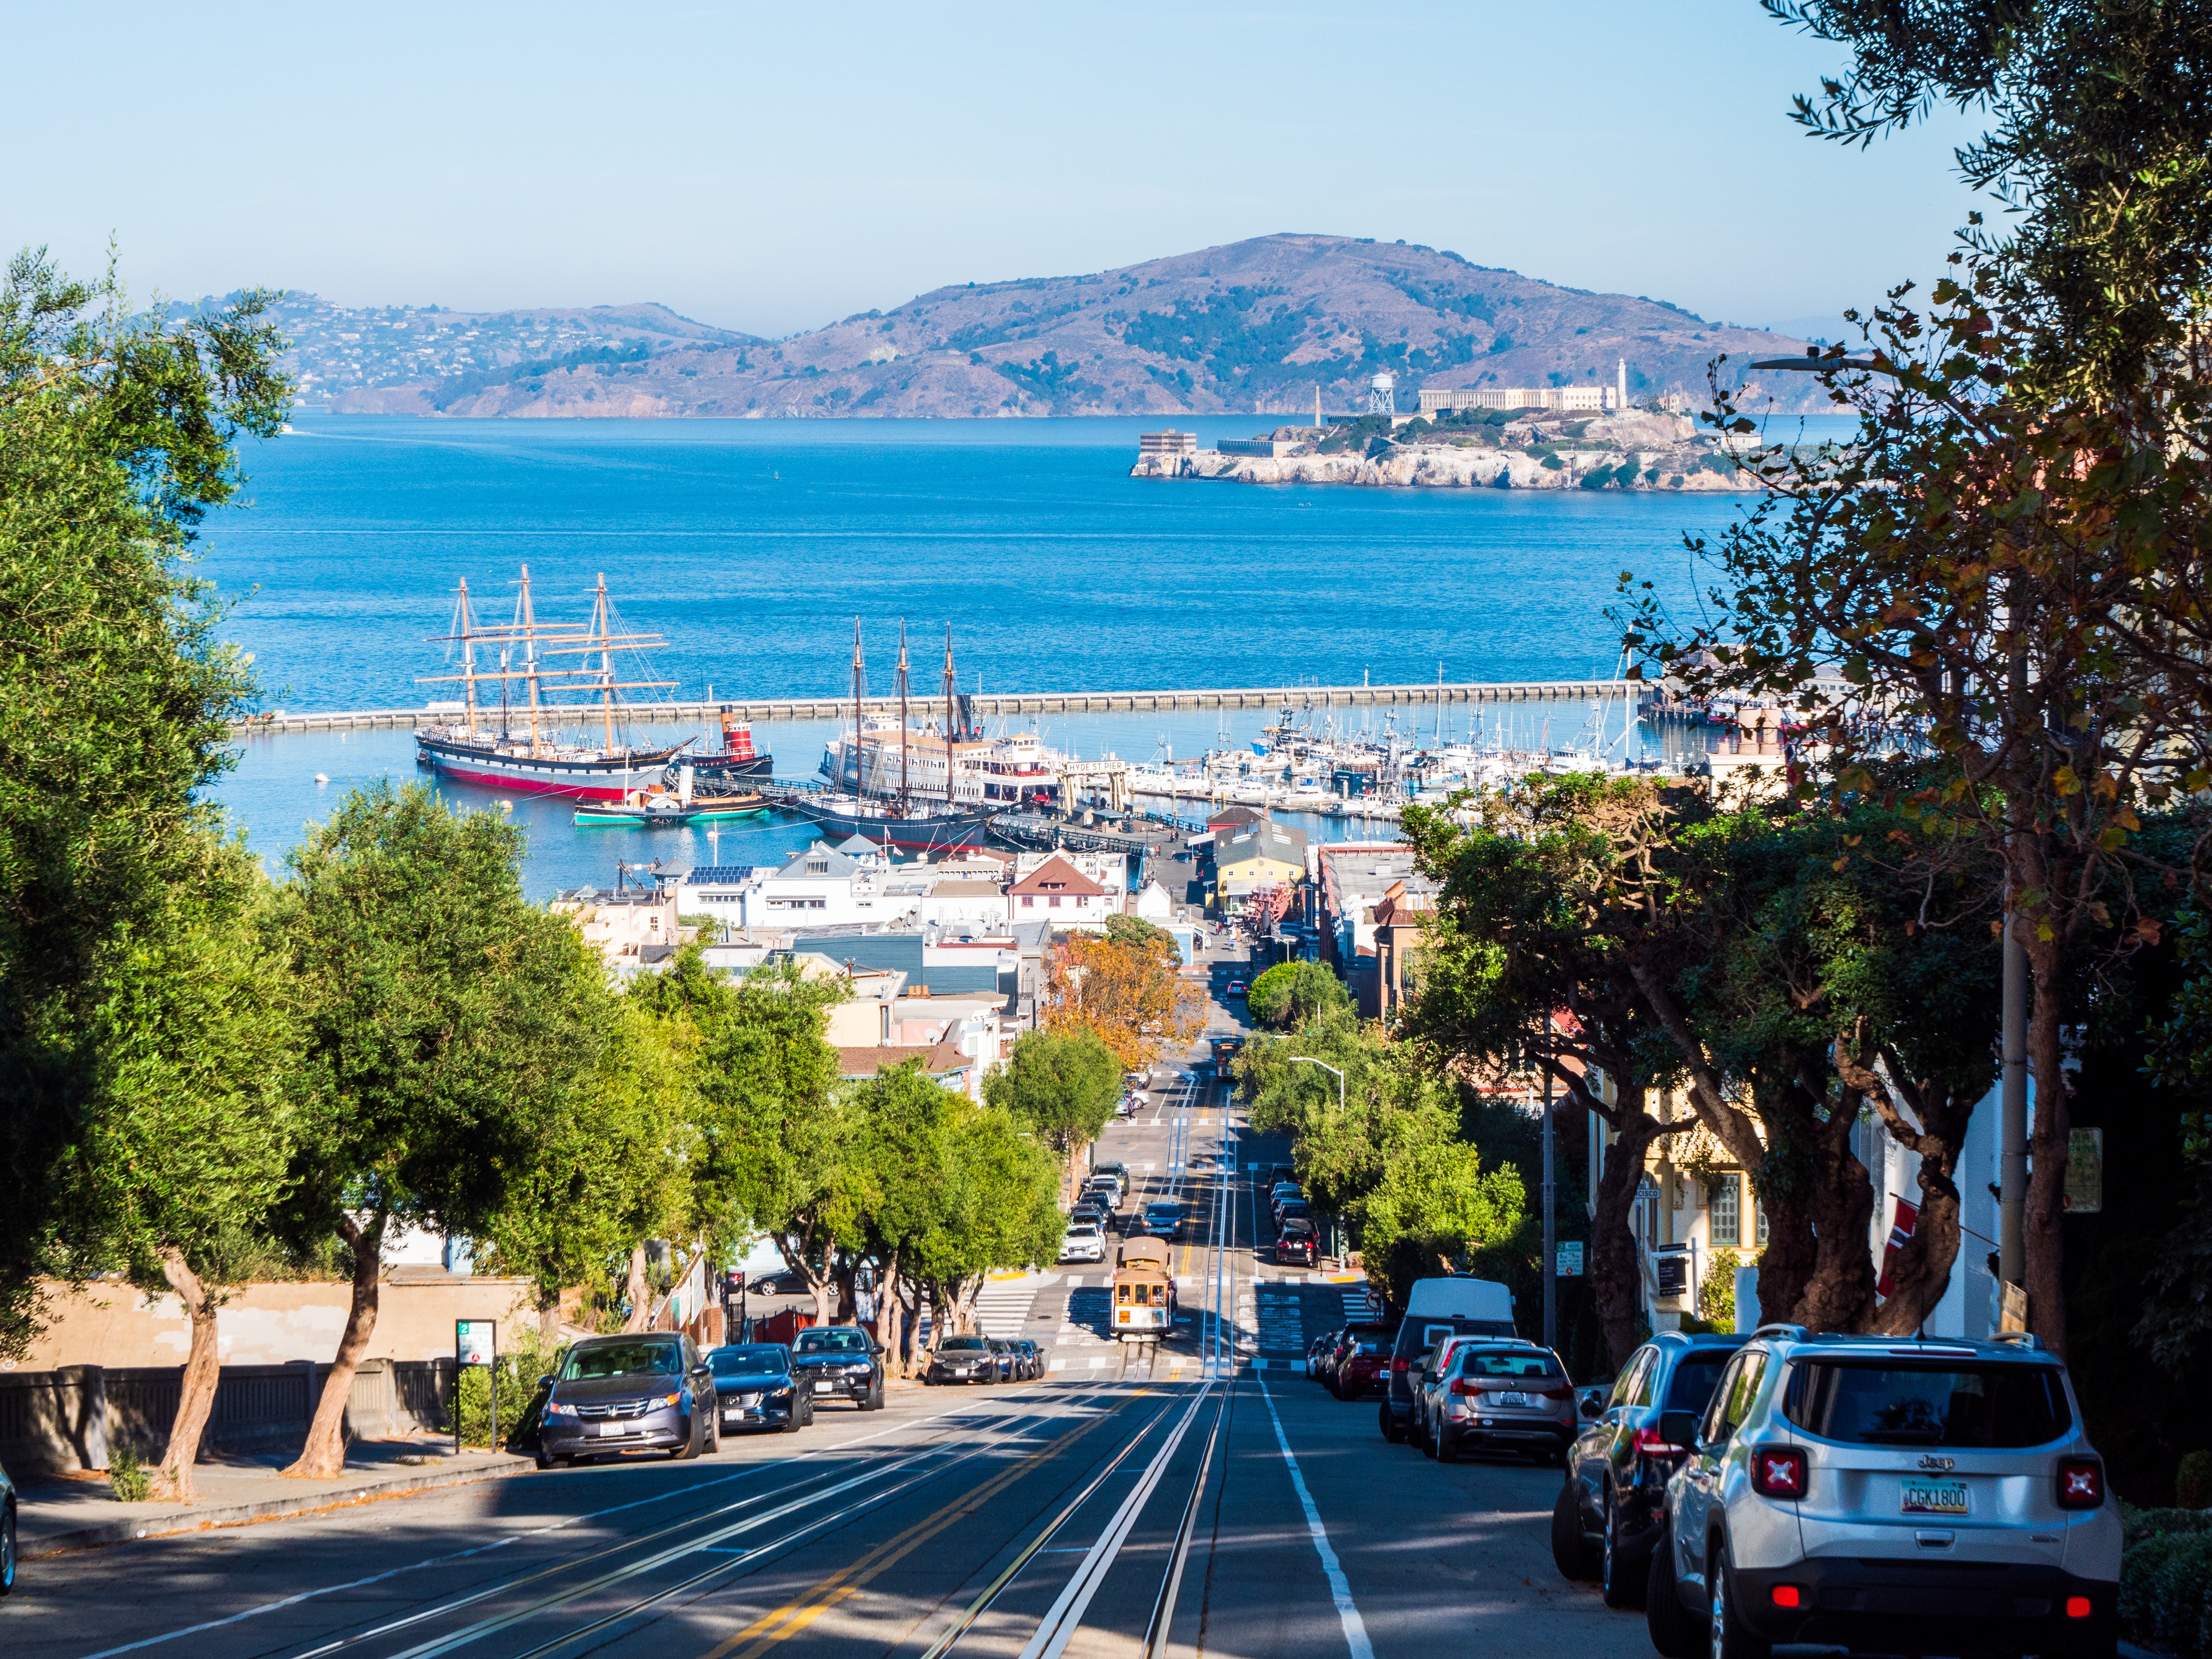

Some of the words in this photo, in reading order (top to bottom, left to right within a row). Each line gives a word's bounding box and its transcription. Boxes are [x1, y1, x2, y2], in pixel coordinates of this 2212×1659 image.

[1070, 763, 1090, 771] HYDE
[461, 1324, 468, 1333] 2
[1918, 1454, 1954, 1471] Jeep
[1909, 1488, 1965, 1506] CGK1800
